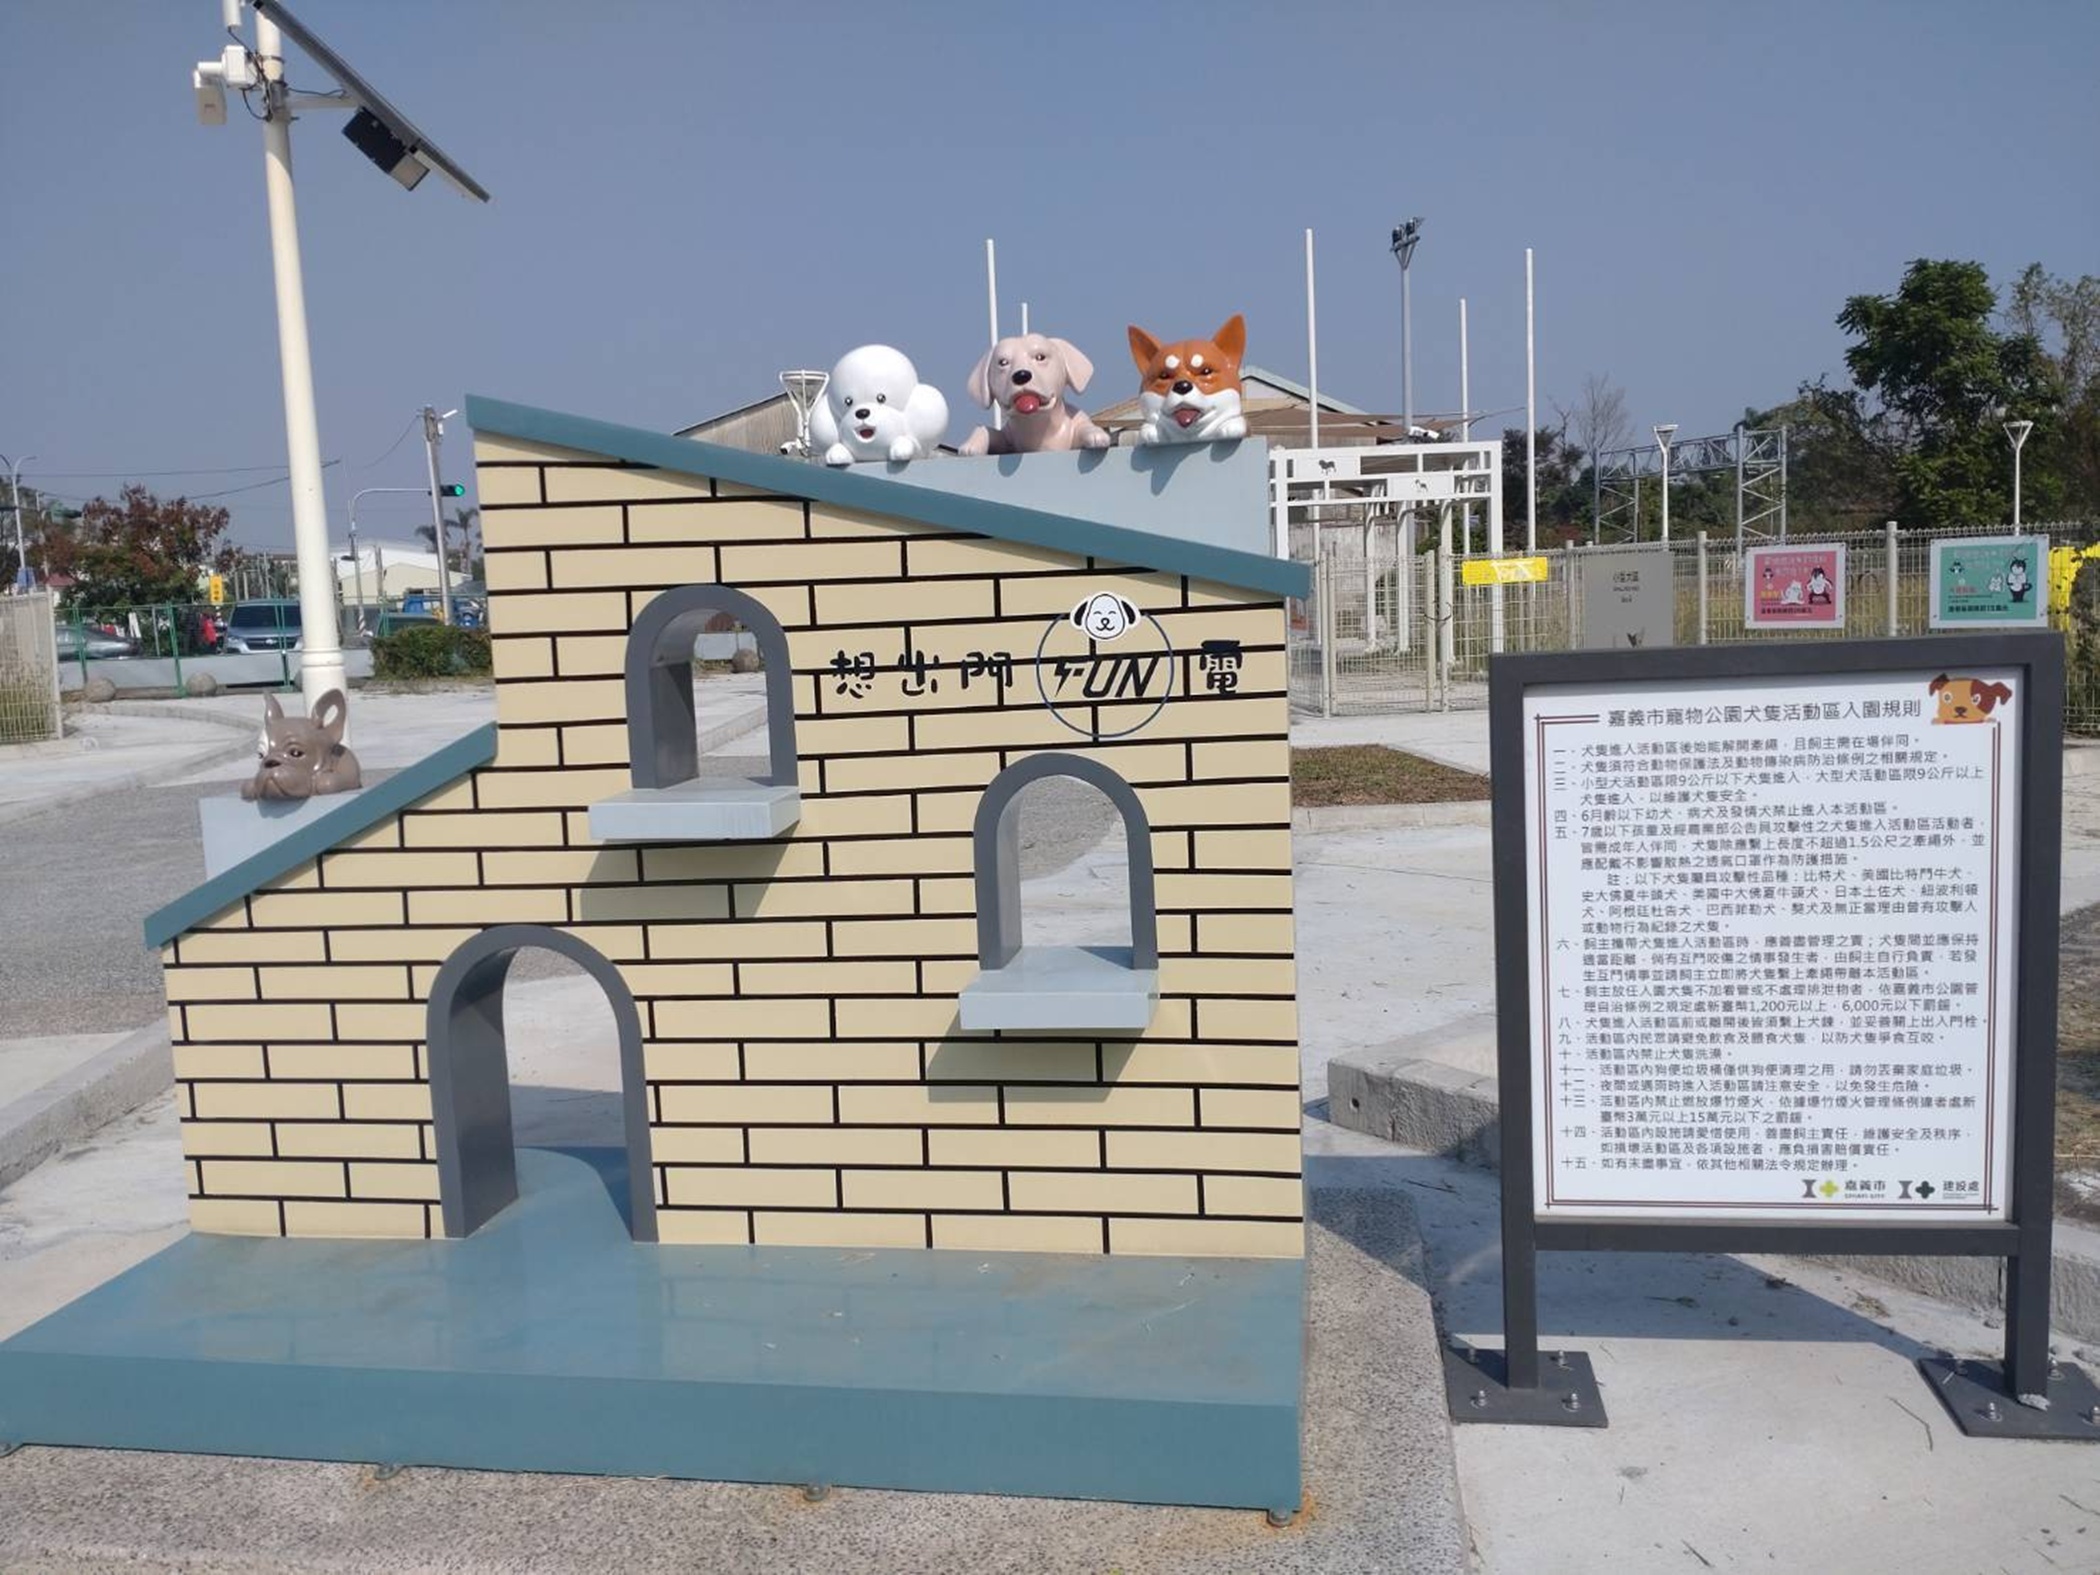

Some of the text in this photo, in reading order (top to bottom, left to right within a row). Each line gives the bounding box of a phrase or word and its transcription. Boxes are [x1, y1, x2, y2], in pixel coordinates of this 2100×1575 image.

[1608, 700, 1921, 727] 嘉義市寵物公園犬隻活動區入園規則
